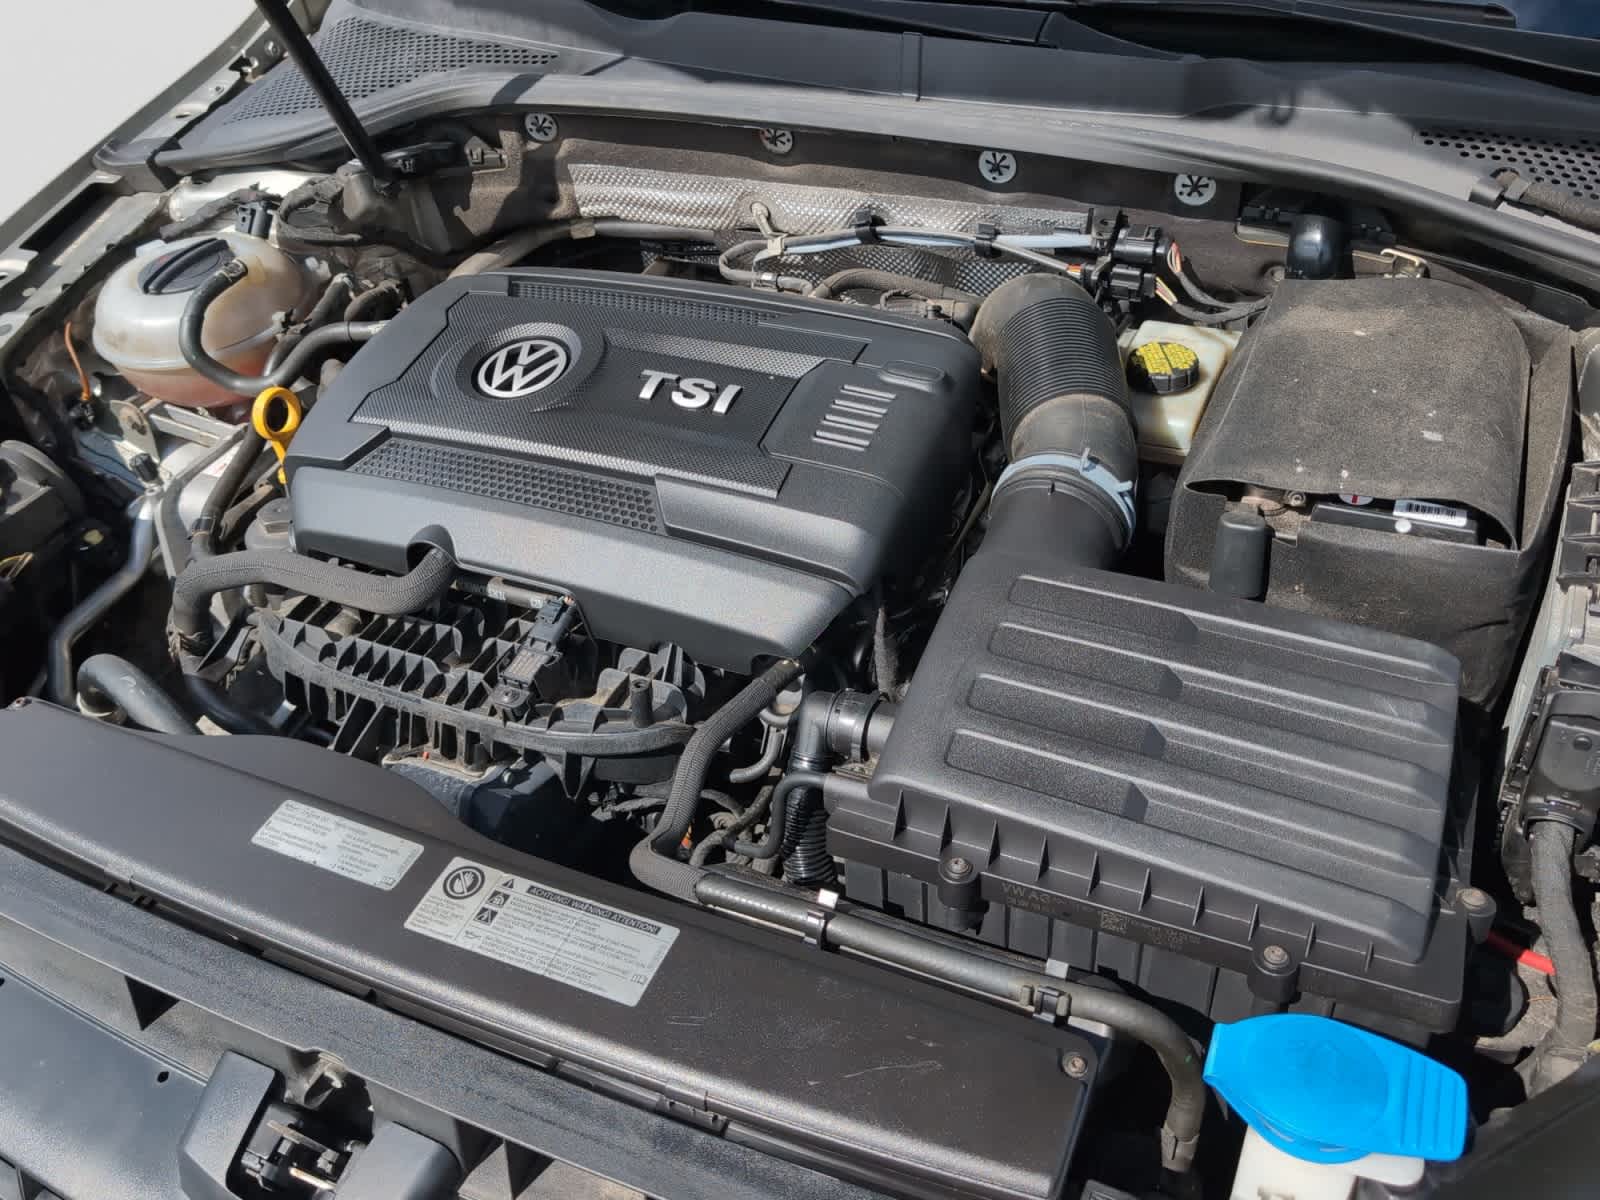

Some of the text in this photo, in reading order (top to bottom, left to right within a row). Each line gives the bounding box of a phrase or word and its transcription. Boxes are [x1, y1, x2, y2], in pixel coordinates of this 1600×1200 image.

[638, 368, 743, 415] TSI
[530, 887, 569, 905] ACHTUNG!
[571, 899, 610, 918] WARNING!
[611, 912, 659, 934] ATTENTION!
[1001, 881, 1025, 897] VW
